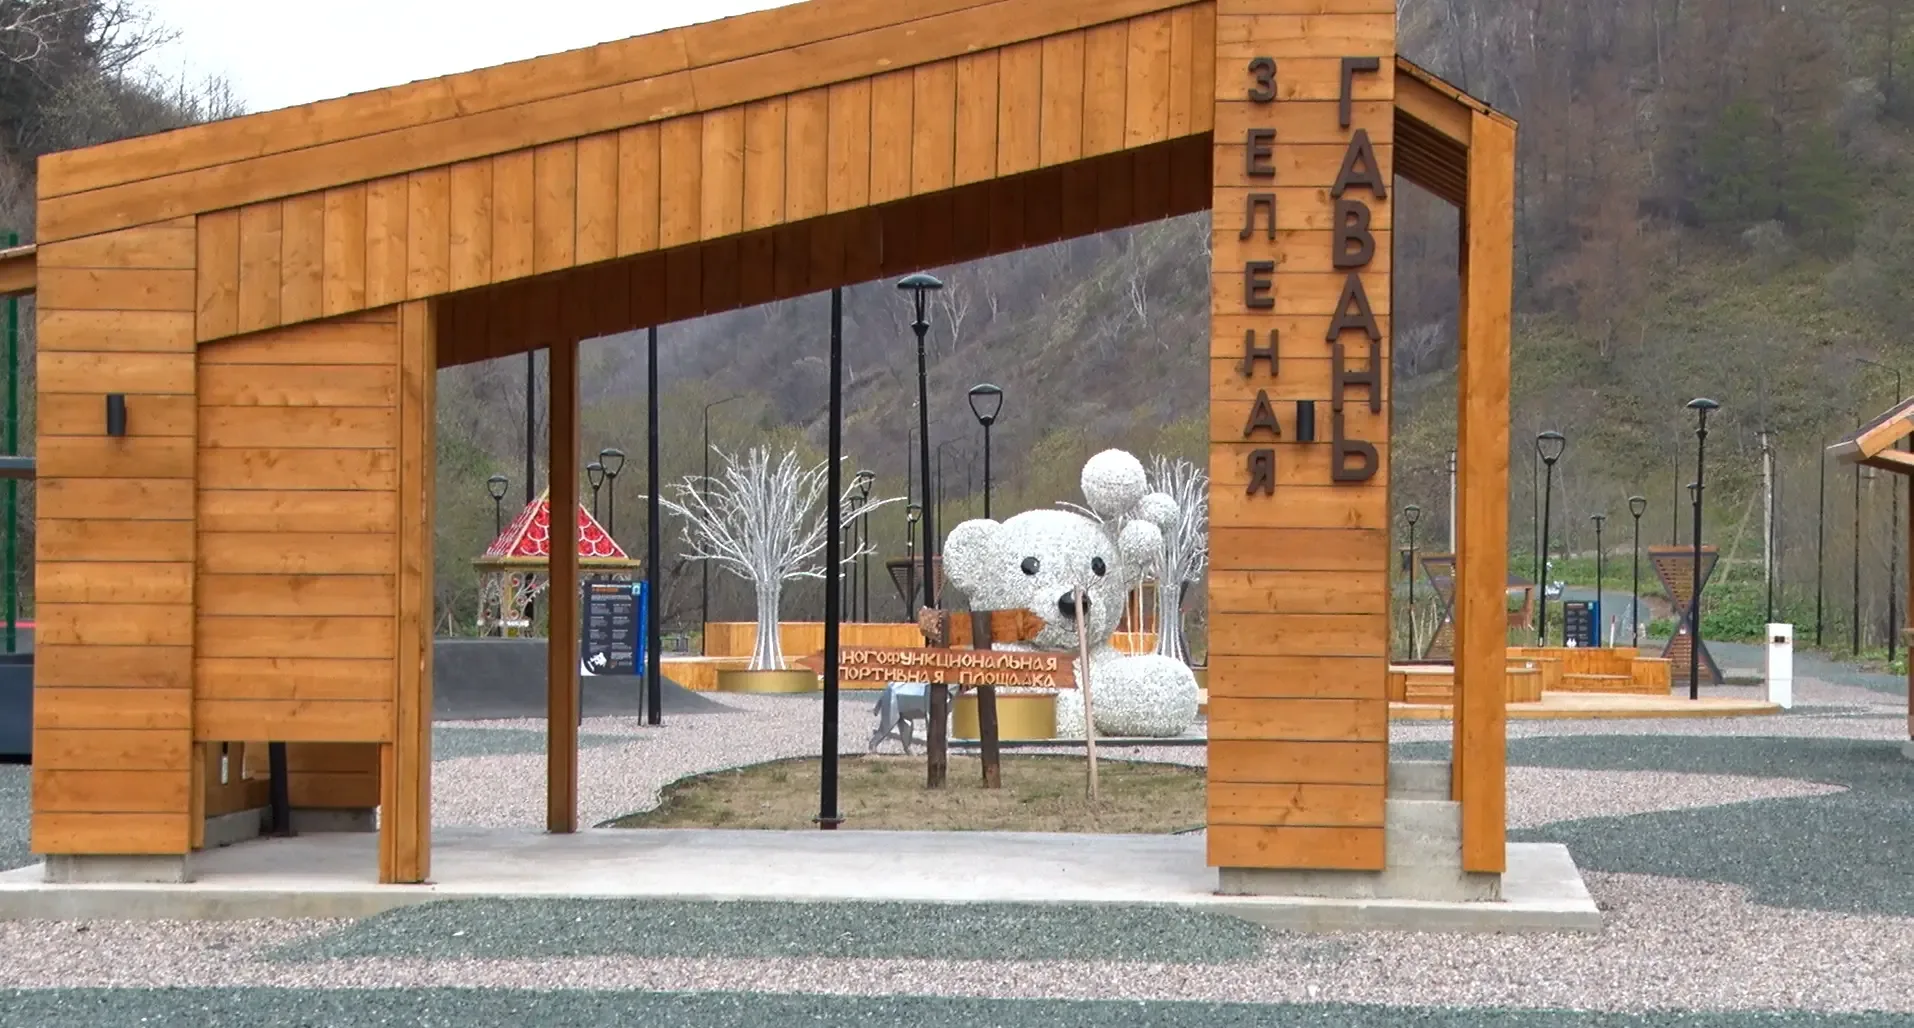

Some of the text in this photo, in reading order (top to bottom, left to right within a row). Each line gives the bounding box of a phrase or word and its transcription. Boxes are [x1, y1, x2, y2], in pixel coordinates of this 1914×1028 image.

[1239, 56, 1282, 496] ЗЕЛЕНАЯ
[1325, 56, 1388, 483] ГАВАНЬ
[838, 650, 1058, 672] НОГОФУНКЦИОНАЛЬНАЯ
[838, 665, 945, 684] ПОРТИВНАЯ
